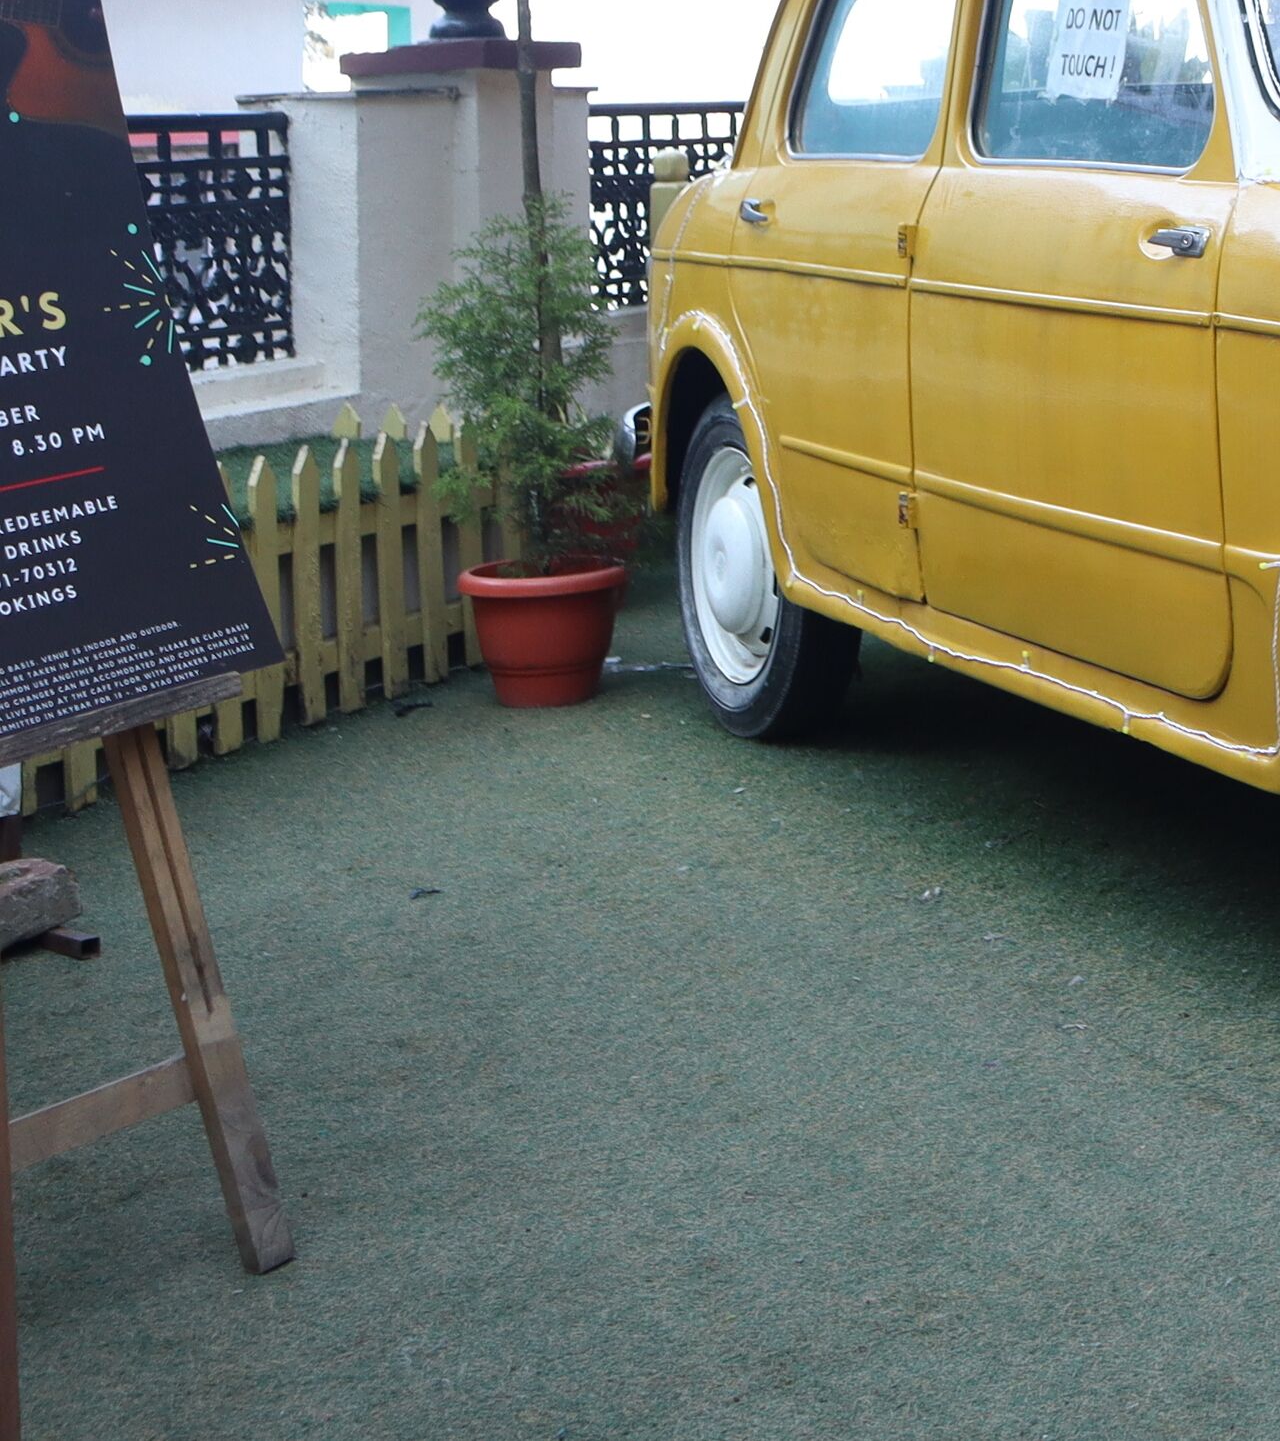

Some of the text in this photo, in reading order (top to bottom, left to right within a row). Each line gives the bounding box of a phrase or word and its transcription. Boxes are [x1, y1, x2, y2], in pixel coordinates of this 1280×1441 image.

[1066, 7, 1121, 31] DO NOT
[12, 423, 105, 456] 8.30 PM
[4, 530, 82, 559] DRINKS
[0, 558, 77, 588] 1-70312
[32, 678, 50, 689] USE
[97, 660, 115, 671] AND
[159, 641, 188, 653] PLEASE
[190, 636, 201, 645] BE
[202, 630, 224, 641] CLAD
[225, 623, 250, 635] BASIS
[41, 650, 69, 664] VENUE
[71, 647, 81, 655] IS
[83, 637, 117, 652] INDOOR
[119, 632, 138, 643] AND
[5, 708, 26, 720] LIVE
[29, 700, 54, 713] BAND
[57, 696, 68, 705] AT
[71, 691, 88, 700] THE
[90, 683, 112, 695] CAFE
[114, 675, 142, 688] FLOOR
[143, 668, 166, 680] WITH
[168, 656, 209, 673] SPEAKERS
[211, 642, 256, 661] AVAILABLE
[12, 674, 24, 683] BE
[27, 666, 57, 679] TAKEN
[58, 662, 70, 671] IN
[72, 656, 91, 666] ANY
[13, 689, 56, 706] CHANGES
[58, 682, 77, 693] CAN
[79, 678, 90, 688] BE
[158, 655, 176, 665] AND
[178, 646, 205, 659] COVER
[207, 636, 239, 651] CHARGE
[240, 633, 250, 642] IS
[44, 712, 55, 721] IN
[57, 701, 92, 716] SKYBAR
[95, 695, 112, 705] FOR
[135, 683, 148, 693] NO
